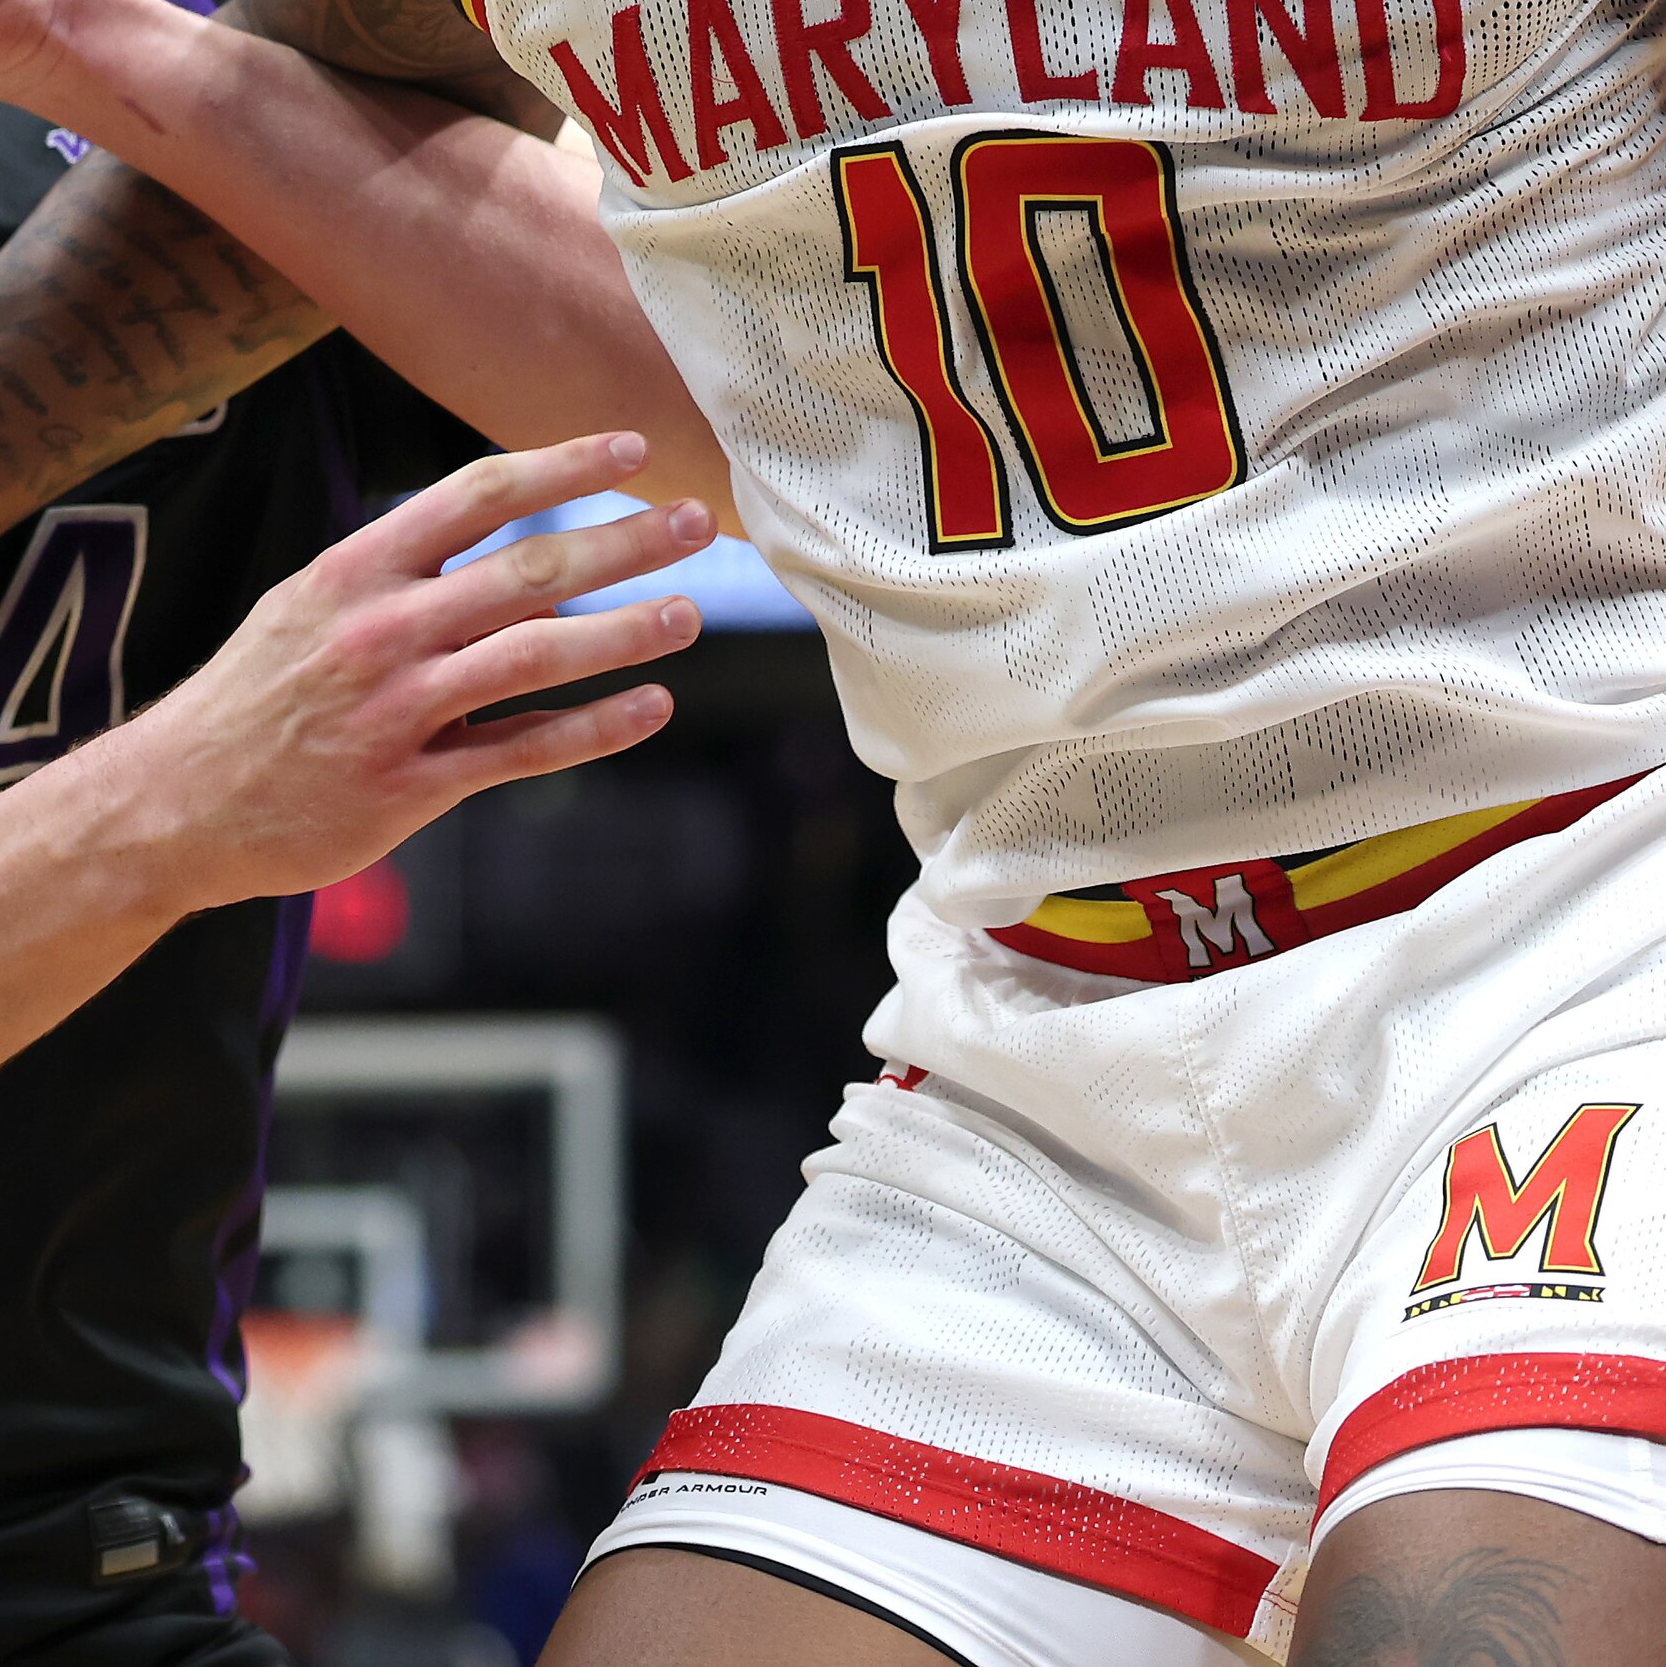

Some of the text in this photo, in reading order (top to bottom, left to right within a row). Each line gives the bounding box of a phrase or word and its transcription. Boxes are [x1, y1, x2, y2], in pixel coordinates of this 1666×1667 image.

[830, 128, 1247, 554] 10
[1153, 873, 1278, 968] M
[1409, 1103, 1644, 1297] M
[675, 1484, 768, 1495] ARMOUR
